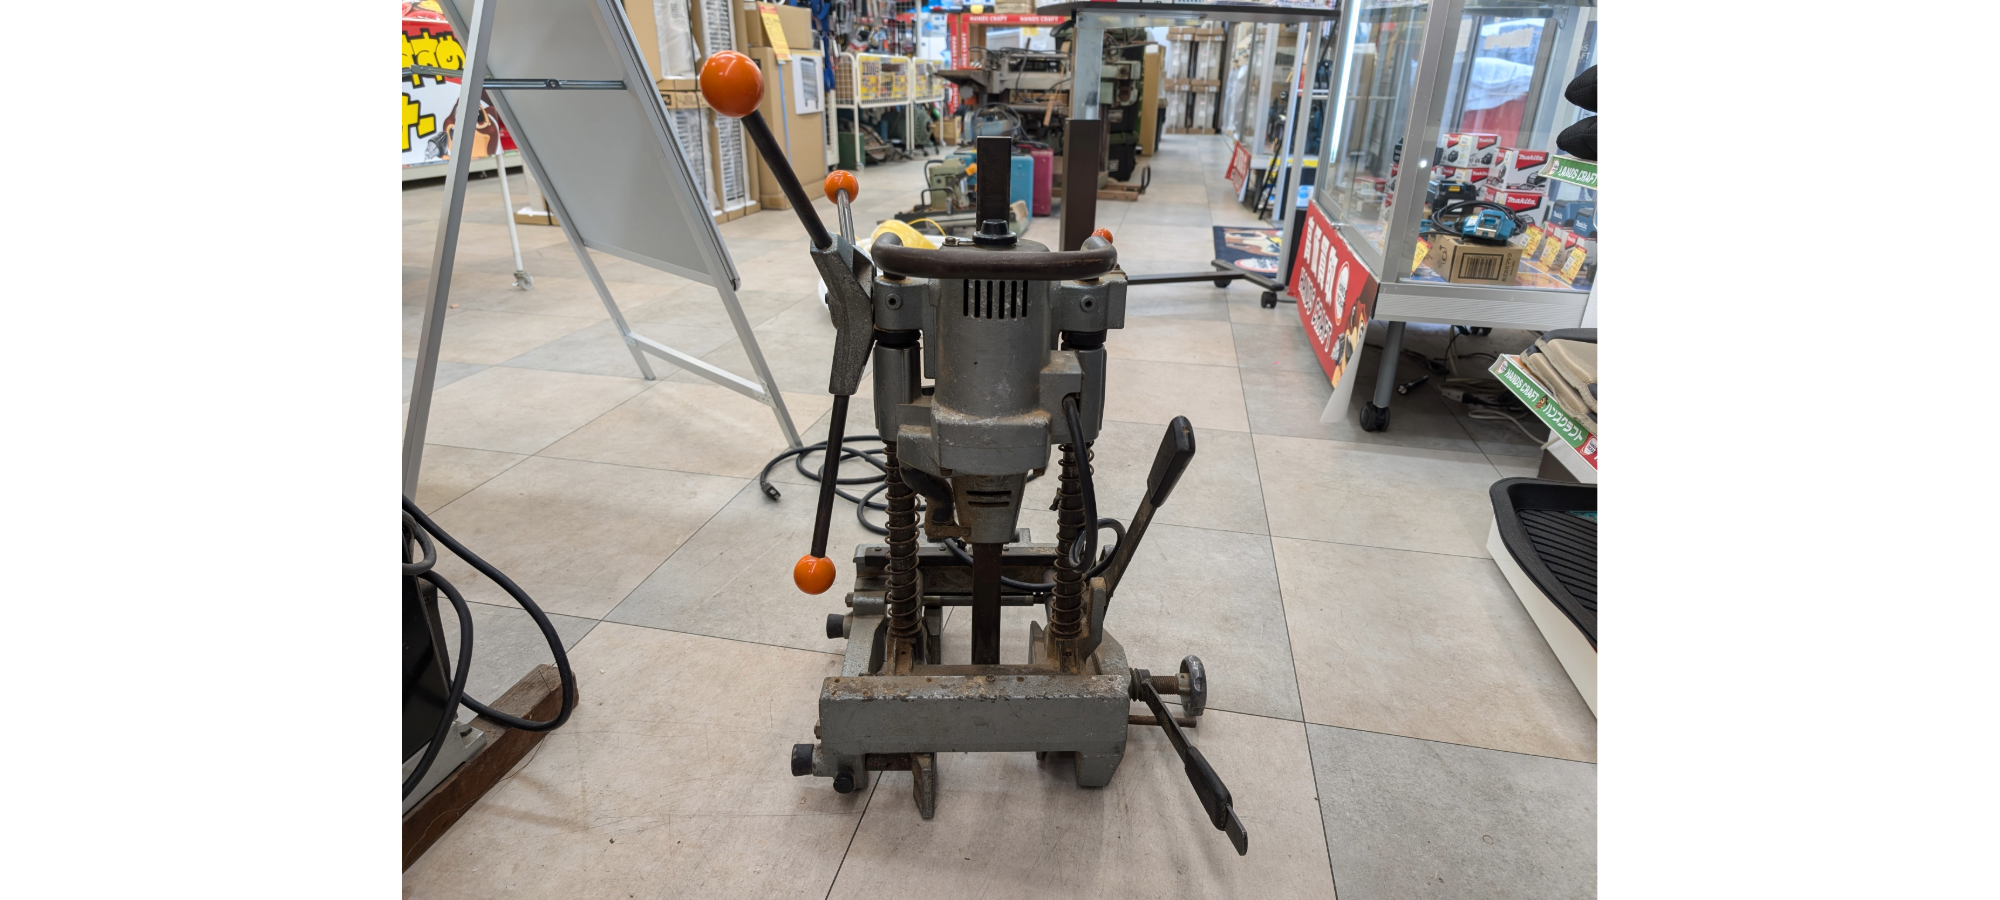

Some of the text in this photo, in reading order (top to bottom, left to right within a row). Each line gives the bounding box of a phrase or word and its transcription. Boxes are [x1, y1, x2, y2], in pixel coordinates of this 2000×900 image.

[1311, 297, 1333, 353] CRAFT
[1504, 368, 1523, 389] HANDS
[1519, 381, 1540, 402] CRAFT
